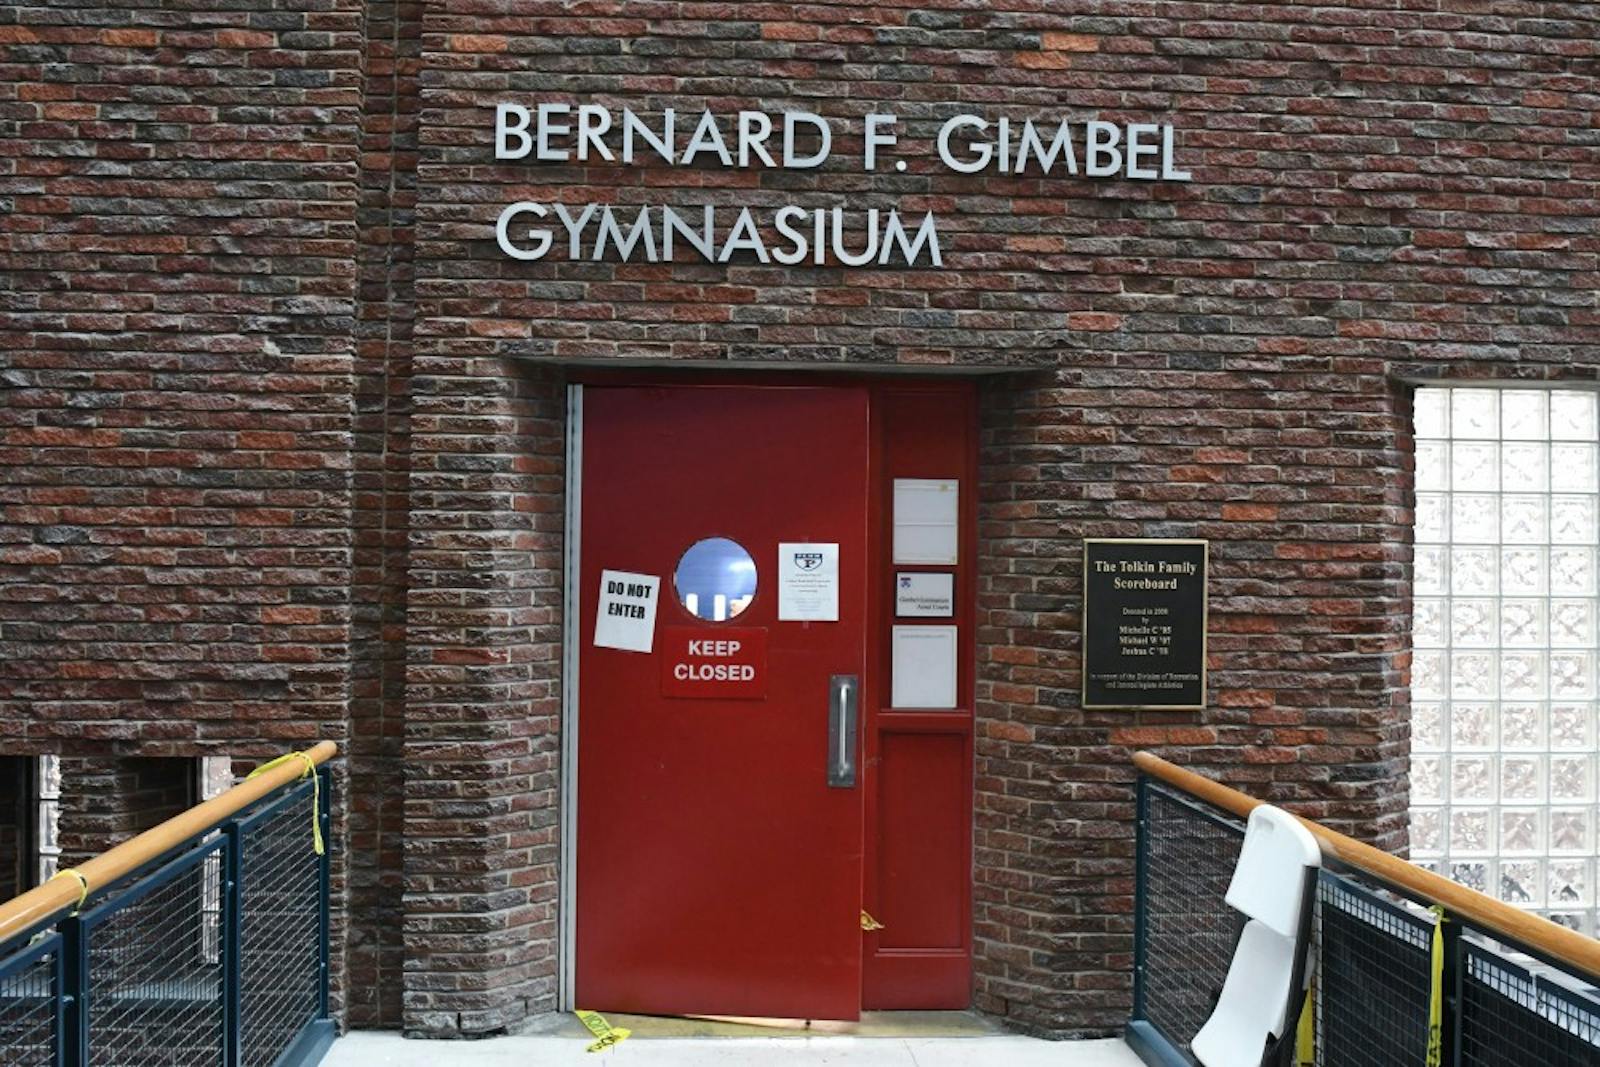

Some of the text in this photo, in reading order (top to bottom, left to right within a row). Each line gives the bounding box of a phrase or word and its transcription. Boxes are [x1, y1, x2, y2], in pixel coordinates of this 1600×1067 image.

[495, 103, 1193, 182] BERNARD F. GIMBEL
[496, 201, 943, 268] GYMNASIUM
[1095, 561, 1197, 576] The Tolkin Family
[607, 580, 652, 599] DO NOT
[1114, 577, 1178, 590] Scoreboard
[608, 602, 645, 620] ENTER
[1119, 626, 1151, 635] Michelle
[1151, 626, 1158, 635] C
[688, 640, 741, 656] KEEP
[1119, 636, 1148, 645] Michael
[1121, 647, 1147, 656] Joshua
[1148, 647, 1156, 656] C
[674, 663, 755, 681] CLOSED
